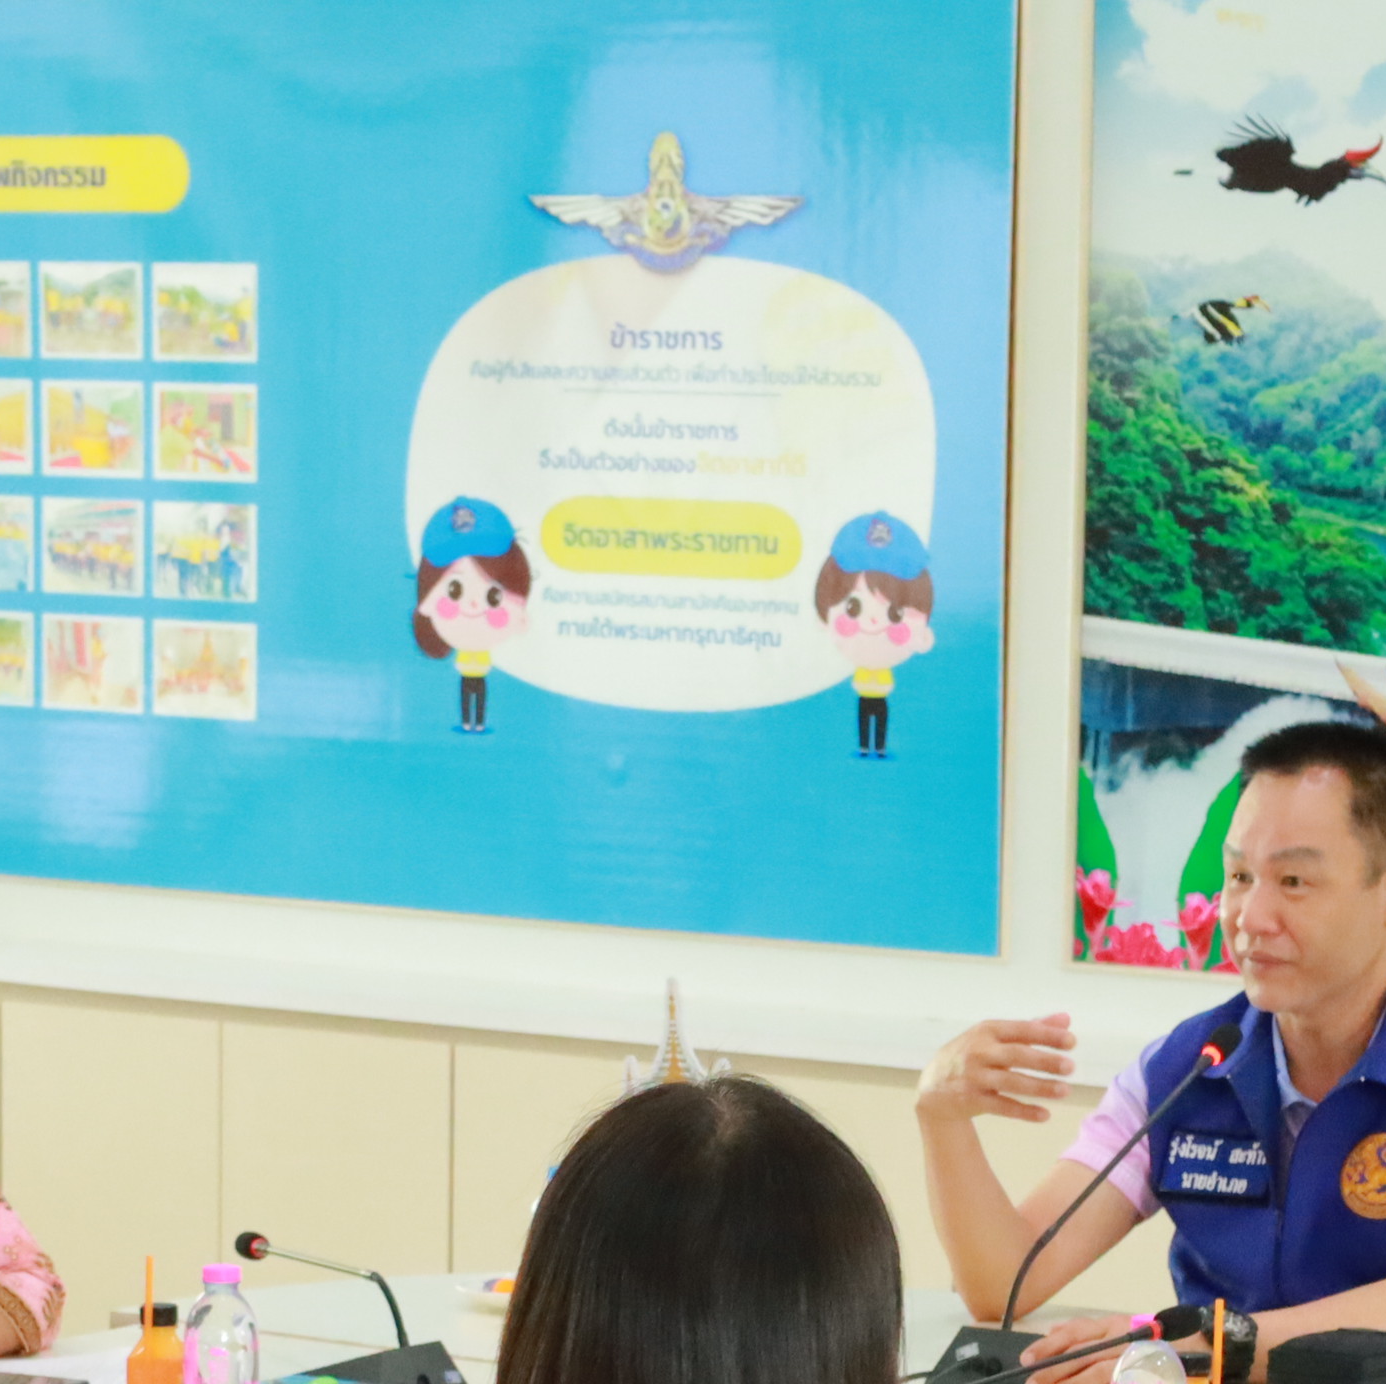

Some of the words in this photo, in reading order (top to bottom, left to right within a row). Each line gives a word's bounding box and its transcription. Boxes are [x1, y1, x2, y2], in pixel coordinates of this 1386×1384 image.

[610, 324, 724, 350] ข้าราชการ
[563, 522, 779, 555] จิตอาสาพระราชทาน
[1181, 1171, 1249, 1195] นายอำเภอ
